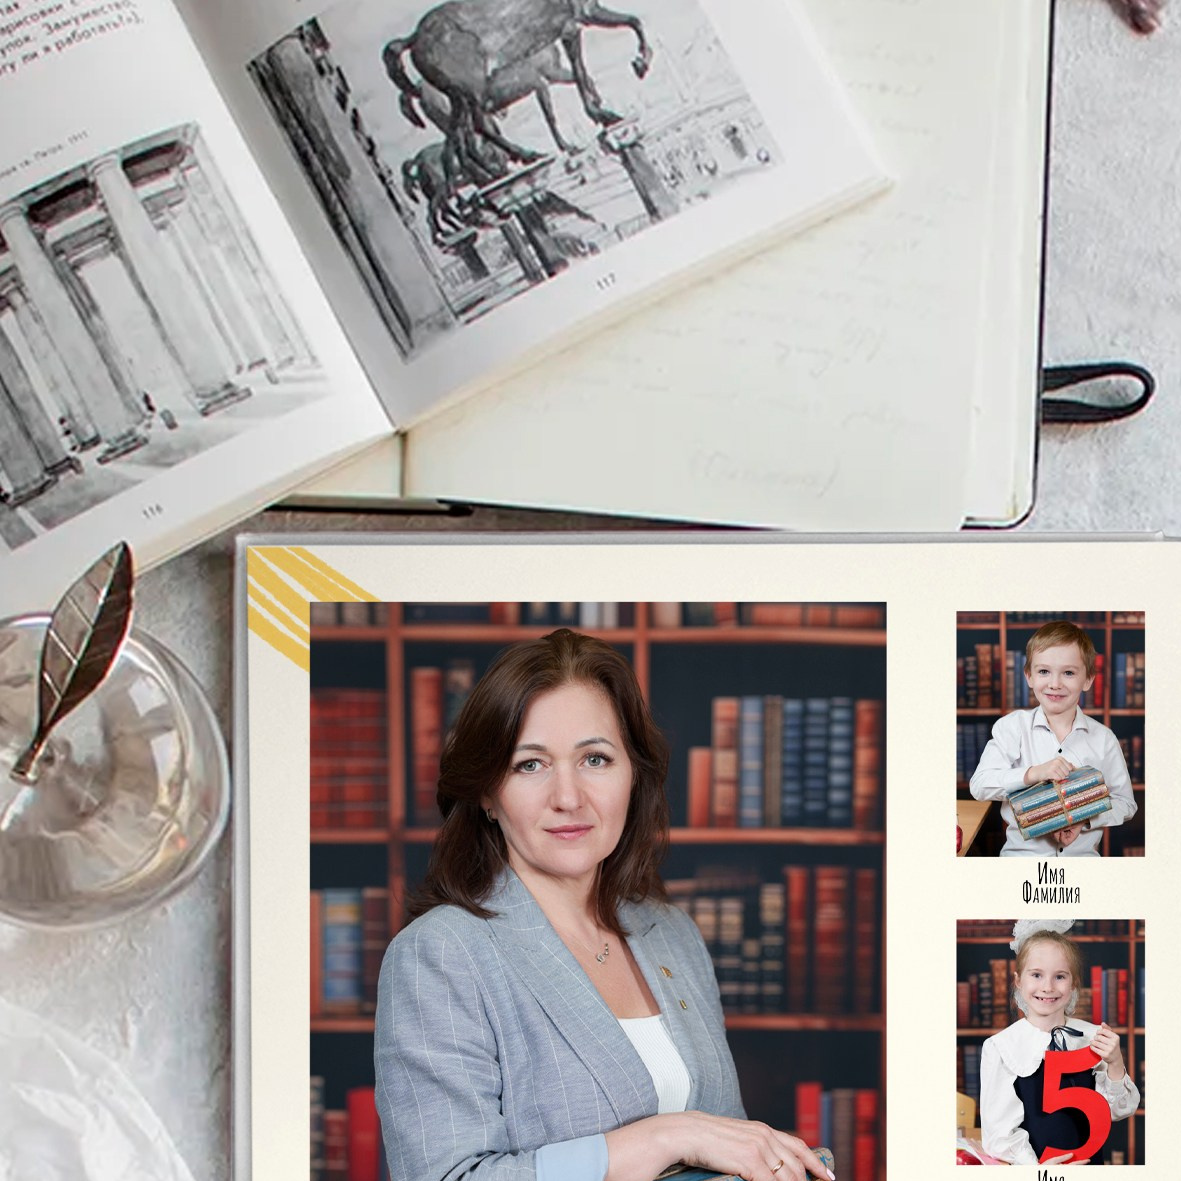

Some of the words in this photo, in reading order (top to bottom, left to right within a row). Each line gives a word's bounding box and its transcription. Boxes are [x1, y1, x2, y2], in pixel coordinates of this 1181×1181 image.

[1037, 861, 1065, 885] Имя
[1022, 879, 1081, 905] Фамилия
[1039, 1046, 1112, 1164] 5
